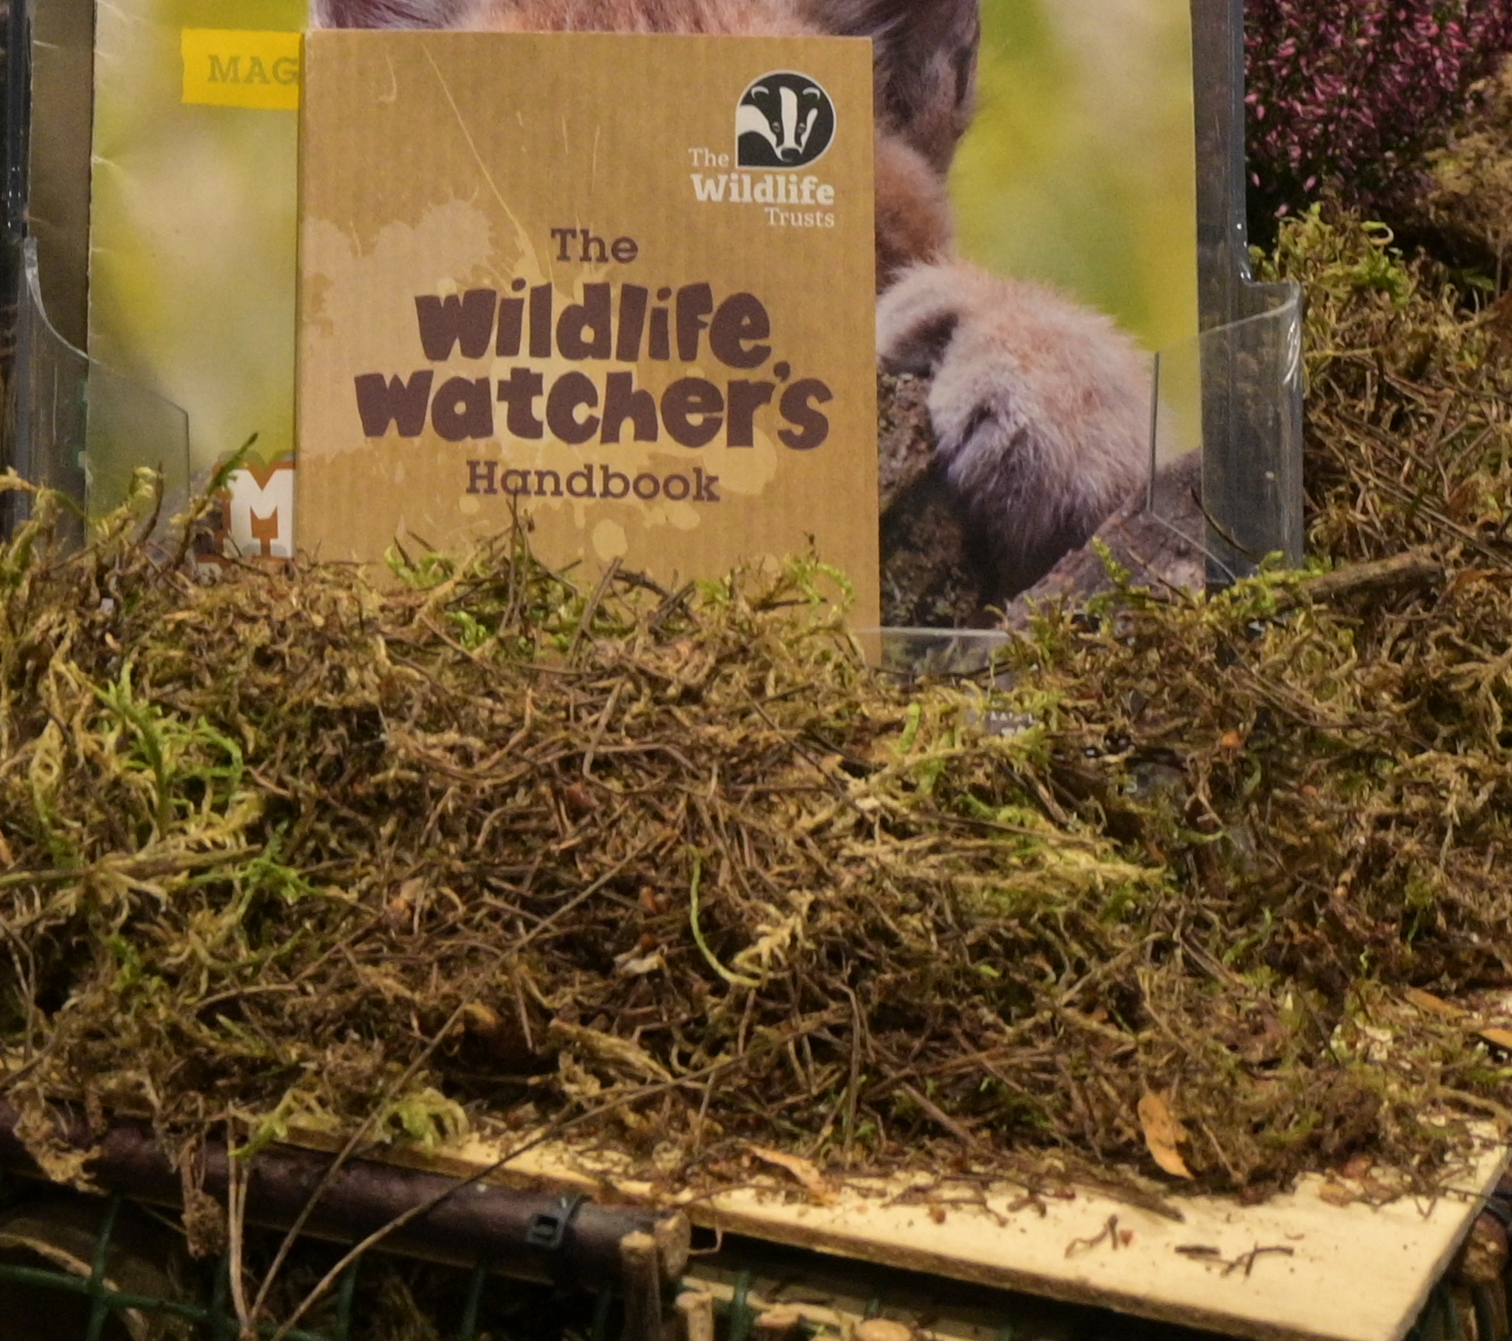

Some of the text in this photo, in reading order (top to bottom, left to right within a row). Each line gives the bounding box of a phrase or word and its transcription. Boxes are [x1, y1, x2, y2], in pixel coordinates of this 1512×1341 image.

[688, 147, 729, 167] The
[690, 172, 835, 206] Wildlife
[764, 206, 835, 228] Trusts
[550, 228, 639, 263] The
[465, 459, 720, 502] Handbook
